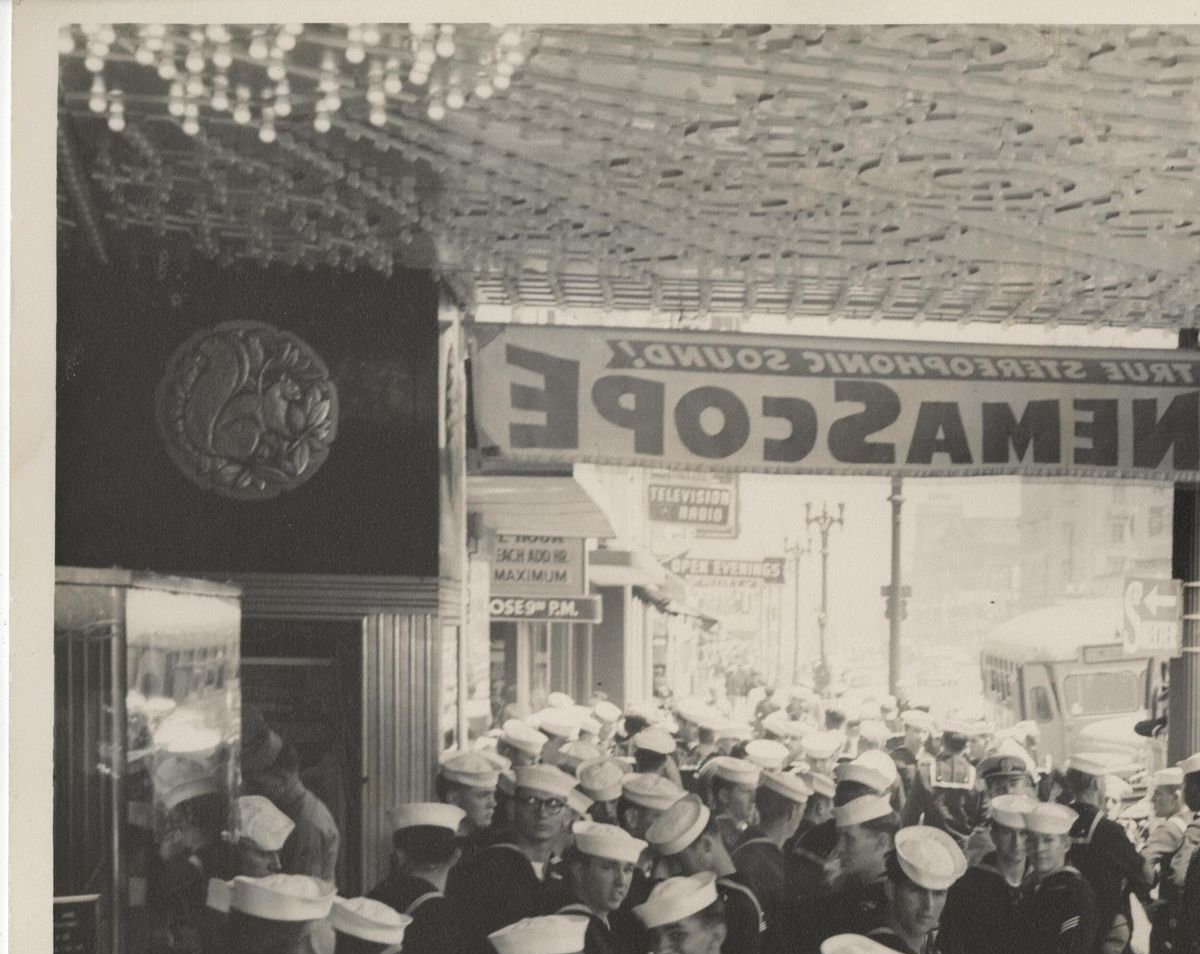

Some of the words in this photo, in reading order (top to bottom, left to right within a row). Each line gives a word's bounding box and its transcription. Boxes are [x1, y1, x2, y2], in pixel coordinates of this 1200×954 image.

[649, 486, 729, 506] TELEVISION
[678, 506, 723, 523] RADIO
[496, 548, 524, 562] EACH
[528, 549, 551, 562] ADD
[494, 569, 568, 583] MAXIMUM
[671, 557, 708, 575] OPEN
[713, 561, 781, 578] EVENINGS
[489, 598, 524, 615] OSE
[548, 600, 579, 617] P.M.
